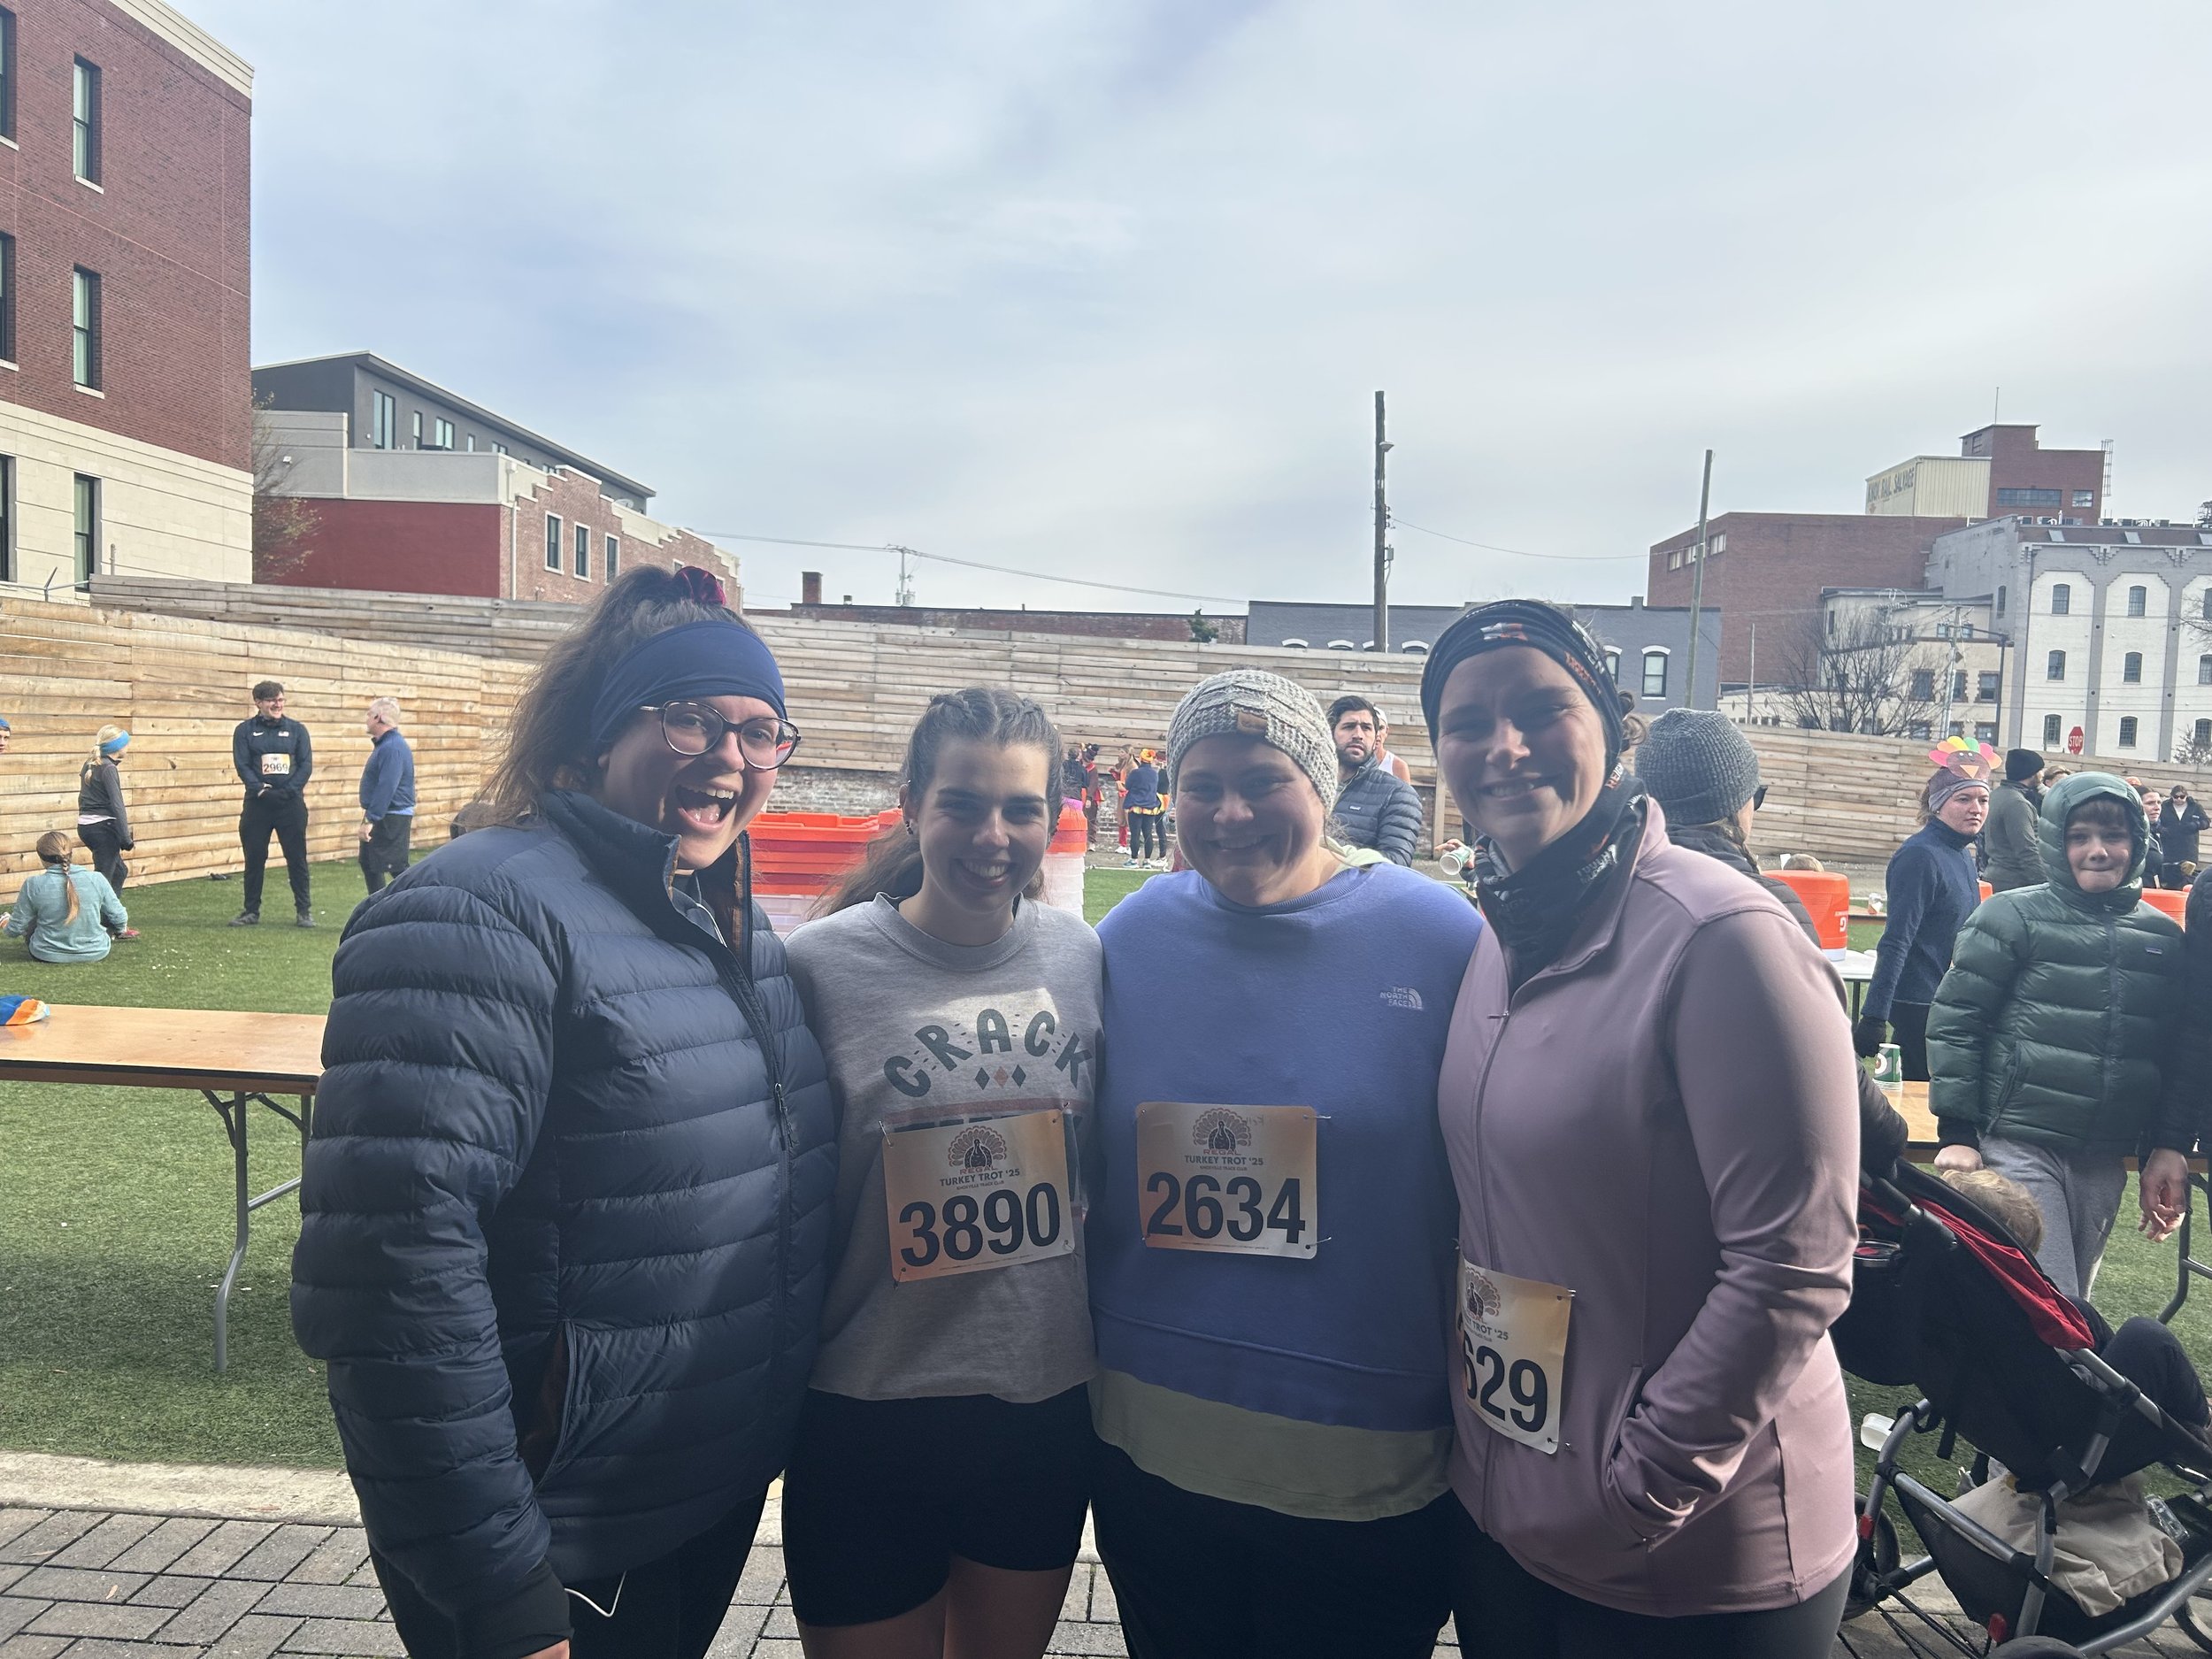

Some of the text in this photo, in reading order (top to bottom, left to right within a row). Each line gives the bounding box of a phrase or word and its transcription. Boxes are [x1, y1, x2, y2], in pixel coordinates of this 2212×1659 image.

[2069, 735, 2083, 748] STOP
[884, 1008, 1093, 1097] CRACK
[959, 1165, 998, 1175] REGAL
[1184, 1156, 1218, 1164] TURKEY
[1222, 1156, 1247, 1165] TROT
[940, 1168, 1020, 1187] TURKEY TROT '25
[1147, 1171, 1306, 1244] 2634
[899, 1182, 1061, 1267] 3890
[1472, 1321, 1492, 1335] TROT
[1494, 1329, 1509, 1340] '25
[1458, 1318, 1548, 1432] 629
